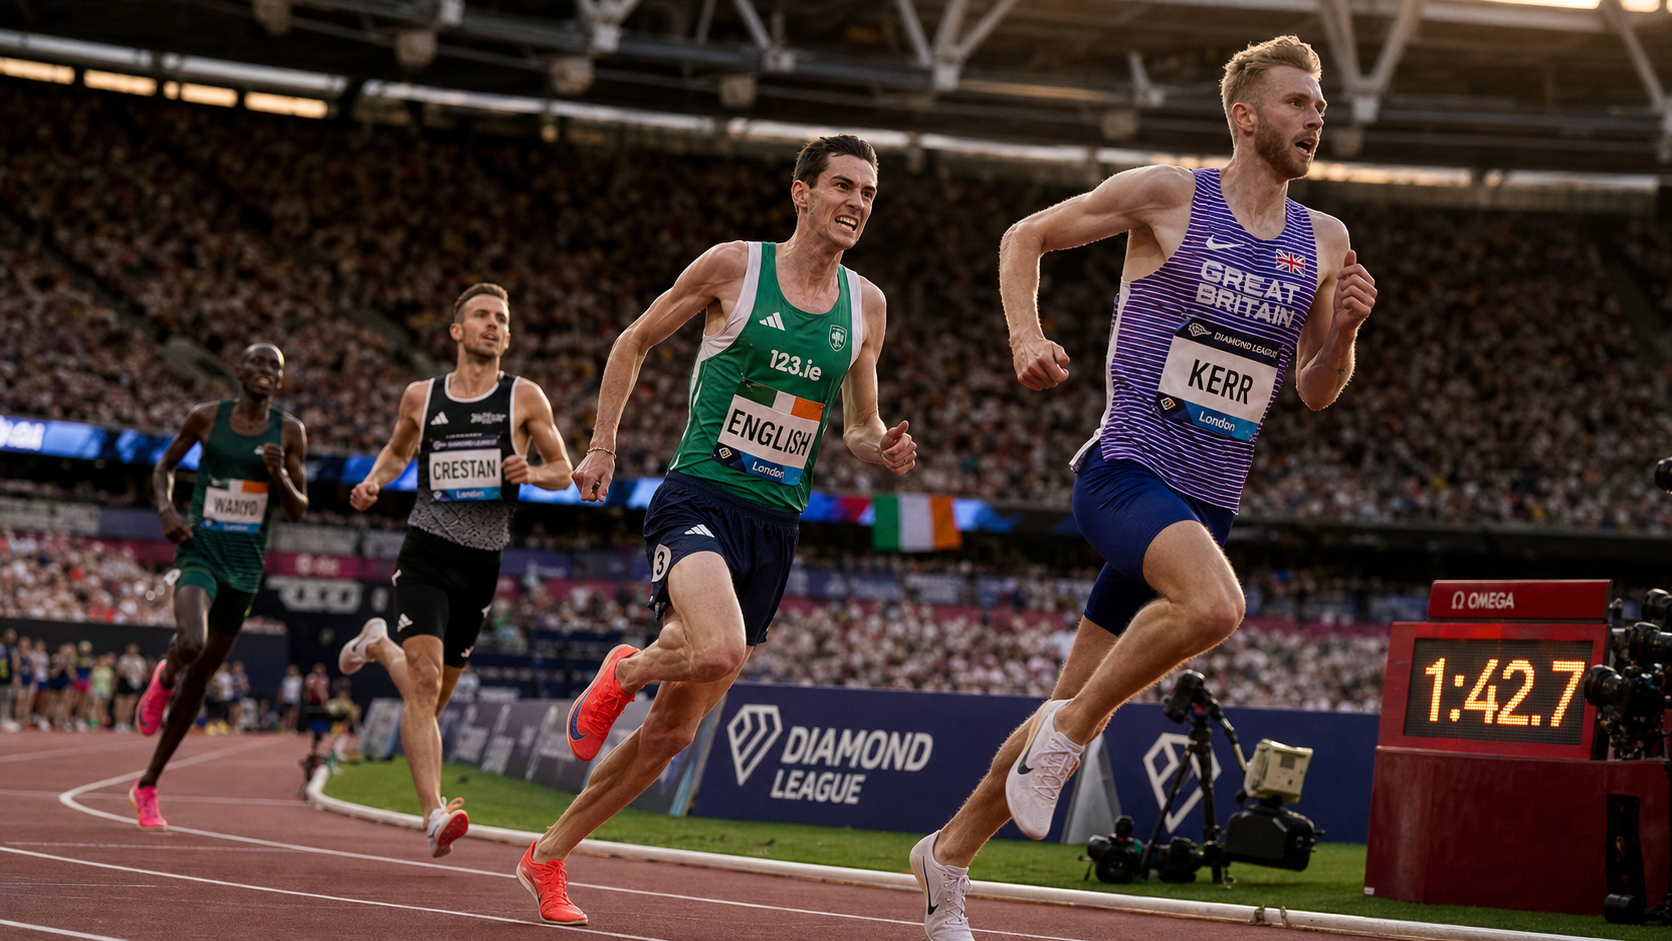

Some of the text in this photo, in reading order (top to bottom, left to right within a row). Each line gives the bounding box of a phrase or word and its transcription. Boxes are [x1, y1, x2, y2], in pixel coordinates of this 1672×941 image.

[1200, 259, 1301, 305] GREAT
[1195, 282, 1295, 329] BRITAIN
[1213, 332, 1252, 350] DIAMOND
[770, 349, 822, 381] 123.ie
[1187, 359, 1254, 405] KERR
[726, 408, 813, 456] ENGLISH
[1198, 411, 1236, 432] London
[433, 459, 496, 480] CRESTAN
[751, 461, 785, 479] London
[456, 489, 485, 498] London
[656, 551, 665, 576] 3
[1468, 592, 1515, 610] OMEGA
[1425, 657, 1586, 728] 1:42.7
[780, 725, 934, 772] DIAMOND
[769, 768, 867, 805] LEAGUE
